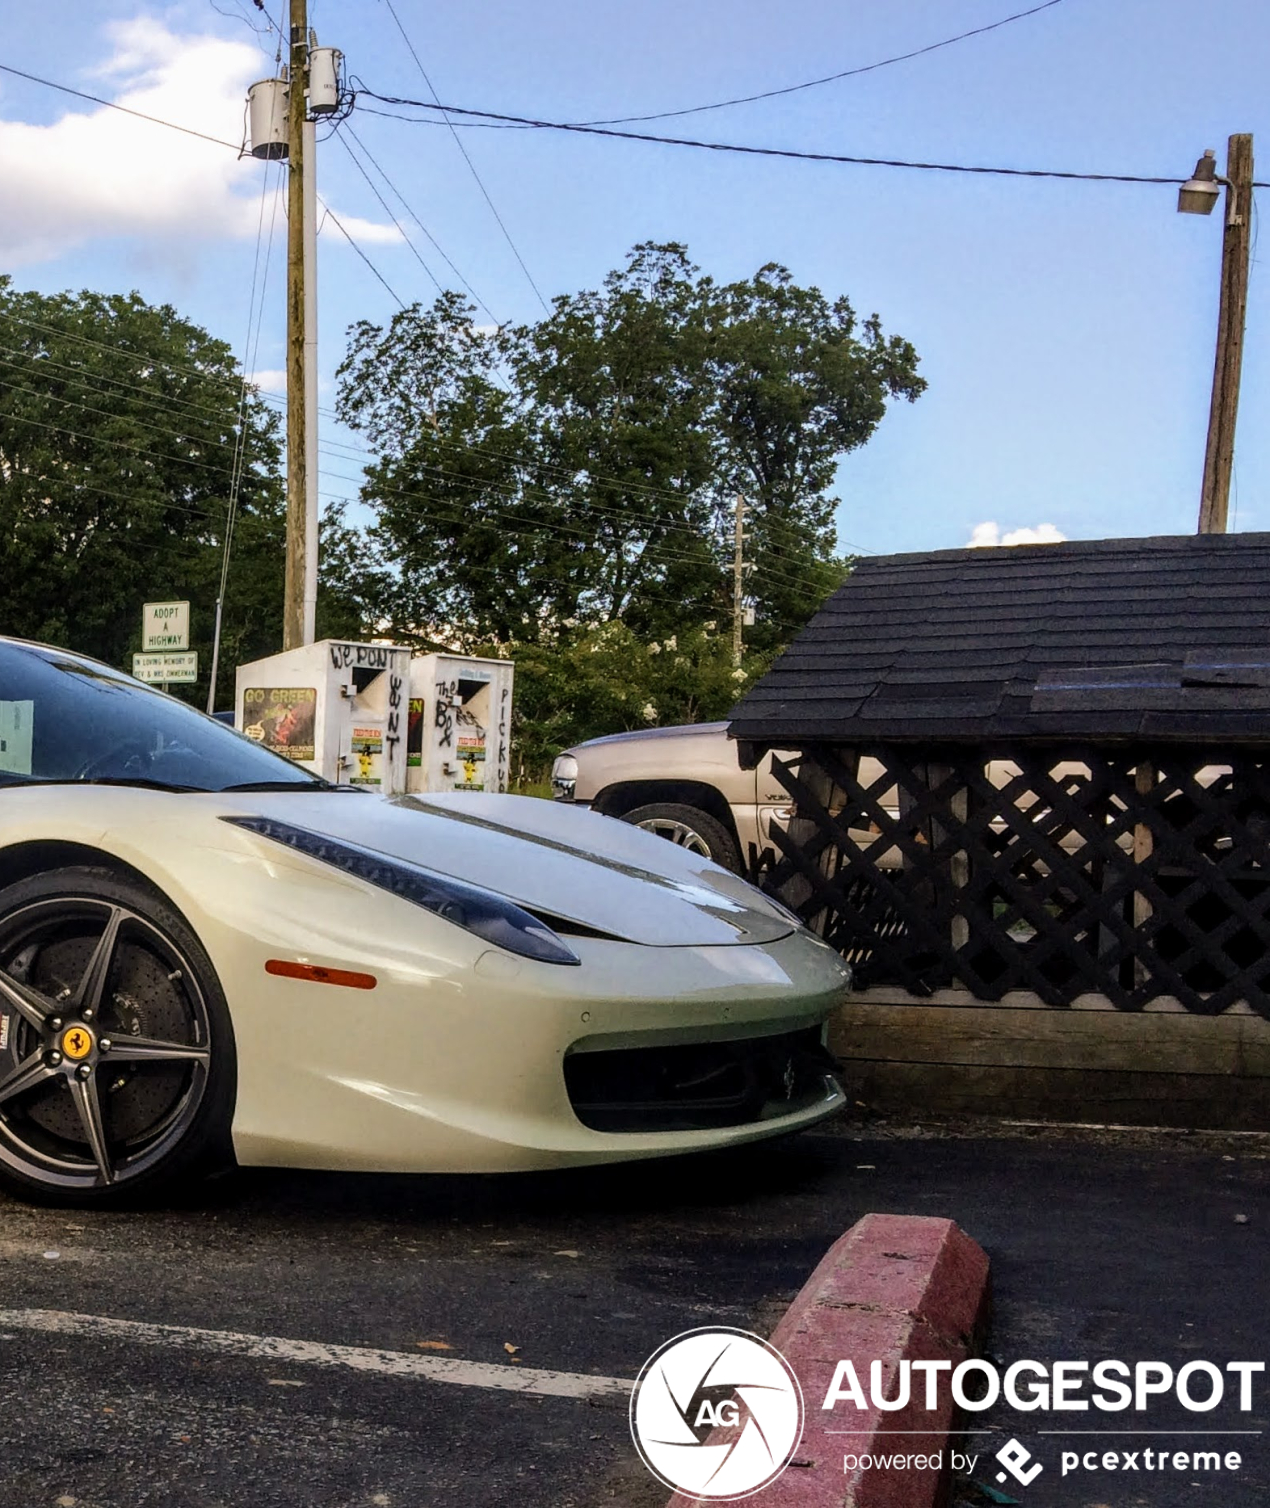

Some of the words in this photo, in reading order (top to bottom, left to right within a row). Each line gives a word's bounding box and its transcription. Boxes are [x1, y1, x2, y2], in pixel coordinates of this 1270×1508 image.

[154, 608, 179, 619] ADOPT
[163, 622, 168, 632] A
[149, 635, 182, 646] HIGHWAY
[164, 657, 186, 665] MEMORY
[245, 689, 265, 703] GO
[270, 689, 315, 704] GREEN
